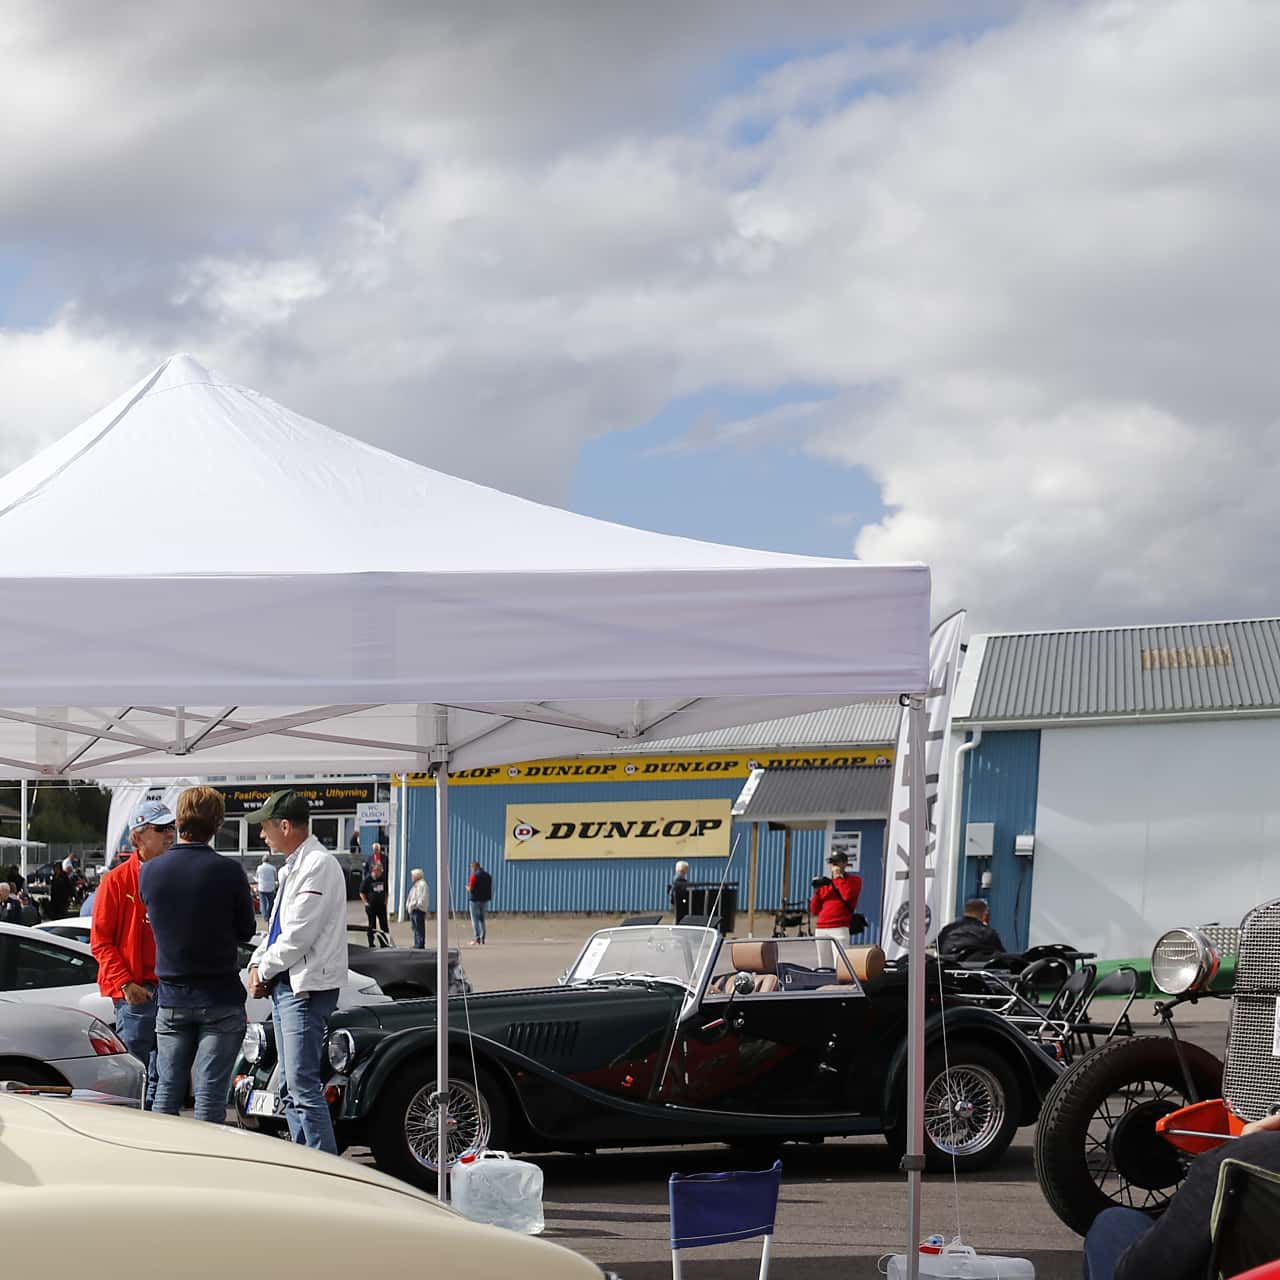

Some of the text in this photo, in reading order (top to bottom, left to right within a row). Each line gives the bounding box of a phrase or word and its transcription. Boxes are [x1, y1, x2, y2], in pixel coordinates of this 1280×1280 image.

[524, 764, 617, 777] DUNLOP
[642, 761, 739, 774] DUNLOP
[545, 819, 723, 840] DUNLOP
